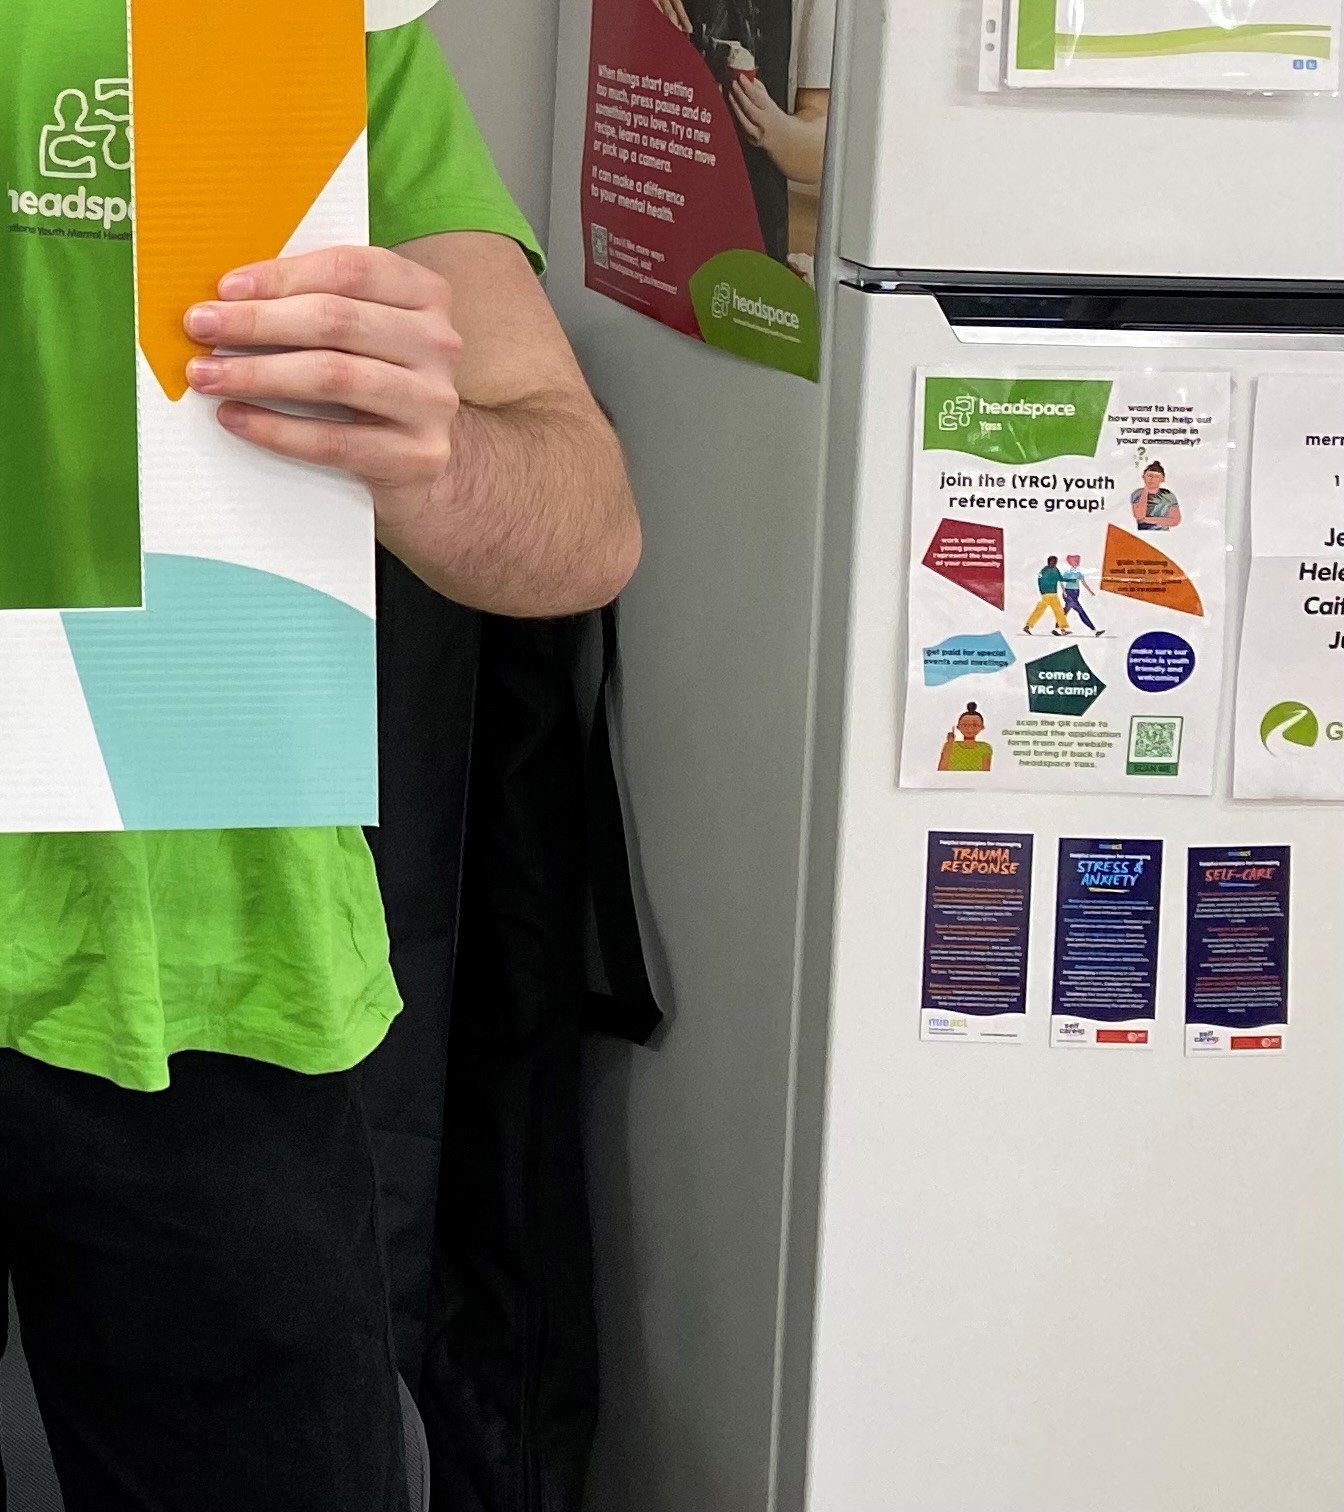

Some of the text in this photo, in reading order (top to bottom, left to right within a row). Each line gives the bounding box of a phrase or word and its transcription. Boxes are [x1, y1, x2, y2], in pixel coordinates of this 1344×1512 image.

[642, 75, 661, 91] start
[663, 81, 693, 102] getting
[631, 94, 653, 108] press
[655, 99, 681, 115] pause
[682, 105, 699, 120] and
[701, 108, 711, 124] do
[633, 113, 648, 128] you
[650, 115, 669, 132] love.
[671, 122, 684, 140] Try
[686, 127, 692, 139] a
[694, 131, 710, 143] new
[618, 126, 640, 144] learn
[642, 135, 648, 146] a
[650, 136, 667, 151] new
[668, 140, 693, 159] dance
[695, 149, 716, 166] move
[594, 140, 672, 173] or pick up a camera.
[599, 169, 611, 183] can
[613, 174, 634, 191] make
[636, 182, 642, 192] a
[644, 181, 685, 206] difference
[591, 183, 598, 197] to
[600, 189, 617, 203] your
[618, 196, 645, 214] mental
[733, 289, 799, 329] headspace
[979, 399, 1075, 417] headspace
[979, 421, 1002, 431] Yass
[1131, 416, 1149, 424] you
[1172, 416, 1193, 424] help
[1142, 438, 1200, 447] community?
[940, 472, 1114, 491] join the (YRG) youth
[949, 495, 1104, 512] reference group!
[971, 659, 1008, 667] meetings
[1039, 670, 1090, 681] come to
[1030, 685, 1097, 698] YRG camp!
[1034, 750, 1059, 758] bring
[1019, 760, 1070, 768] headspace
[952, 848, 1009, 862] TRAUMA
[941, 861, 1020, 874] RESPONSE
[1077, 859, 1143, 874] STRESS &
[1081, 874, 1138, 887] ANXIETY
[1206, 868, 1275, 881] SELF-CARE
